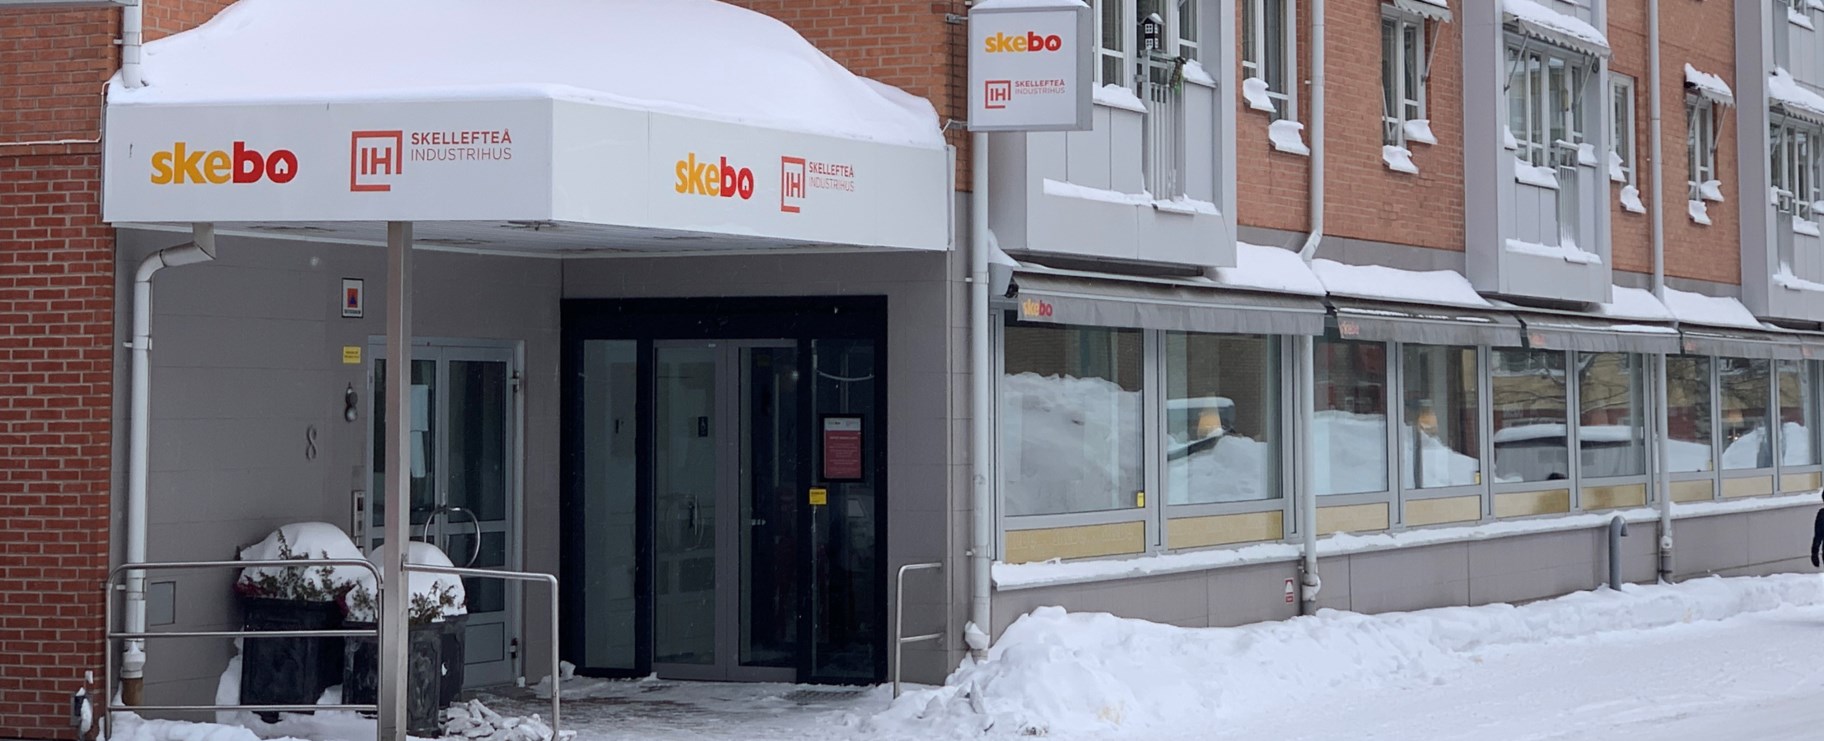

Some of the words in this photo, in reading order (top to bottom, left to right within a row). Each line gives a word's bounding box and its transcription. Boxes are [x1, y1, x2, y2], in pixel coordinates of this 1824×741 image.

[985, 31, 1062, 53] skebo
[1014, 87, 1065, 96] INDUSTRIHUS
[410, 128, 512, 145] SKELLEFTEÅ
[150, 141, 298, 184] skebo
[410, 147, 512, 161] INDUSTRIHUS
[675, 152, 754, 200] skebo
[809, 176, 855, 192] INDUSTRIHUS
[305, 424, 317, 460] 8
